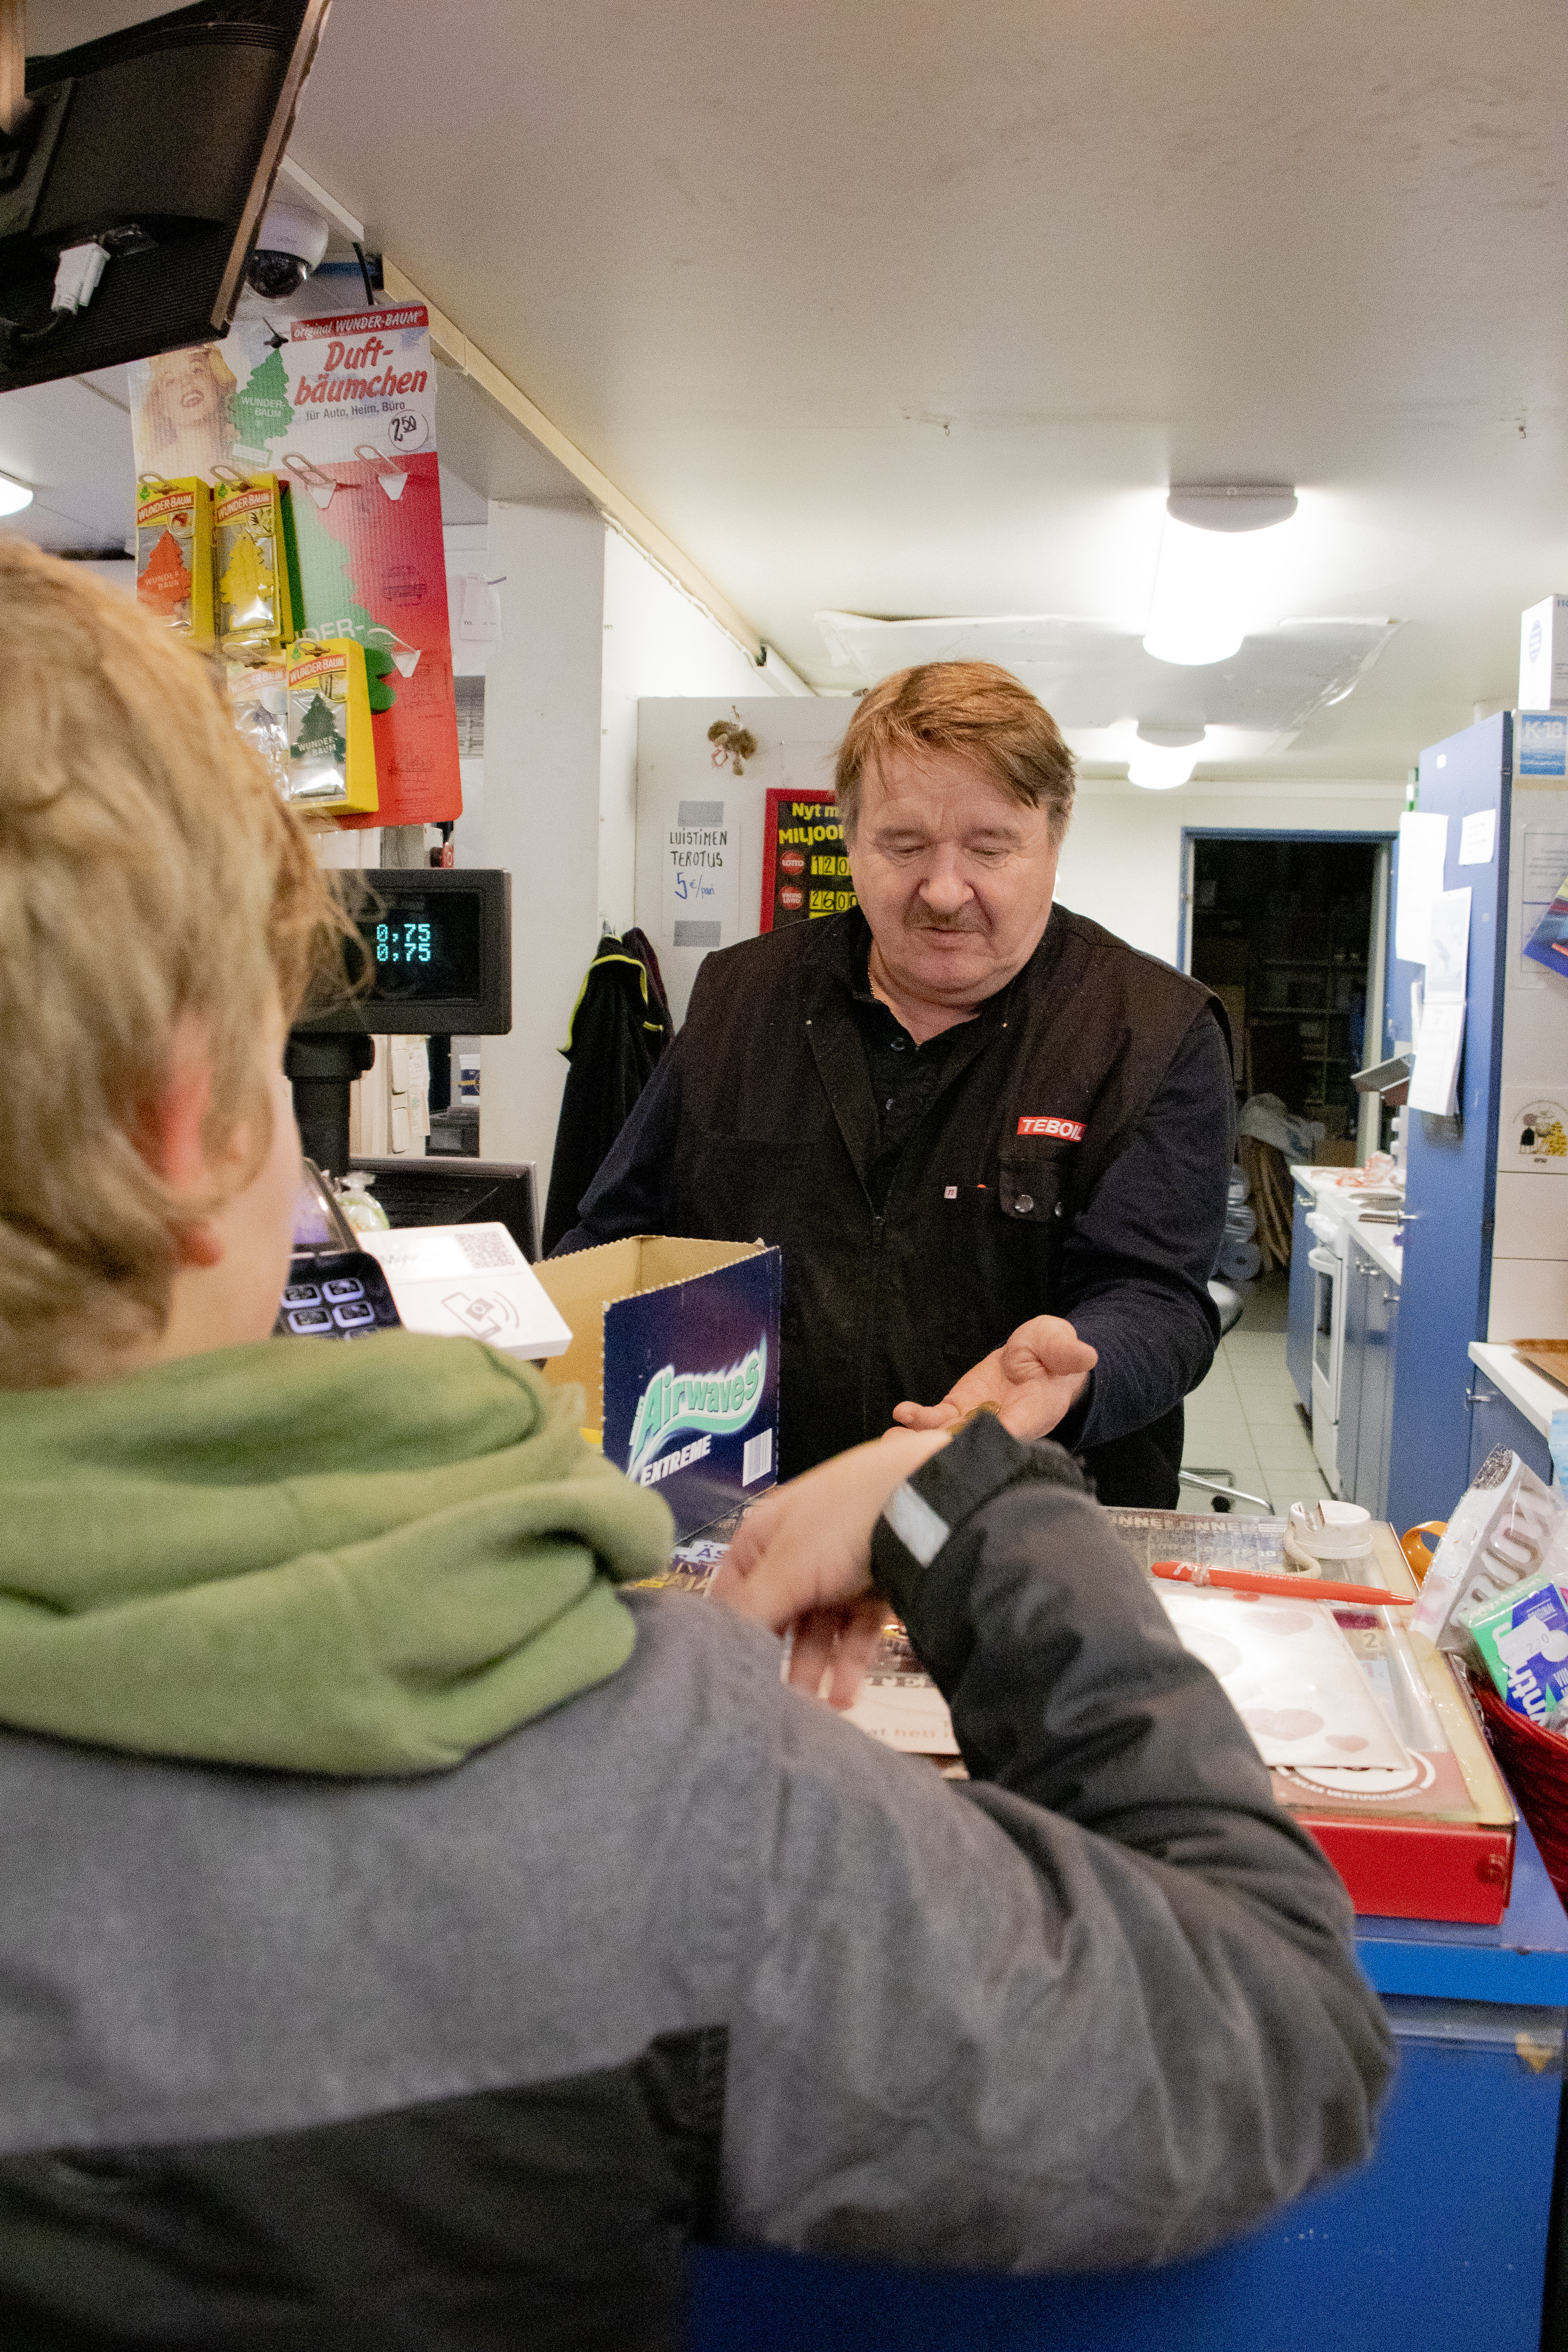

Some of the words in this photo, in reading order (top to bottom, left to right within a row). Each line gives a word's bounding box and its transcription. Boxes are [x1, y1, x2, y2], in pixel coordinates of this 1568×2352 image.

[294, 321, 332, 339] original
[324, 337, 393, 372] Duft-
[294, 366, 428, 406] bäumchen
[306, 410, 320, 421] für
[323, 407, 348, 419] Auto,
[351, 404, 380, 416] Heim,
[382, 401, 405, 412] Büro
[138, 495, 192, 521] WUNDER-BAUM
[218, 493, 269, 519] WUNDER-BAUM
[290, 657, 345, 683] WUNDER-BAUM
[1525, 720, 1563, 739] K-18
[792, 802, 820, 820] Nyt
[670, 850, 723, 868] TEROTUS
[376, 924, 431, 942] 0,75
[376, 943, 431, 962] 0,75
[1022, 1118, 1082, 1140] TEBOIL
[634, 1358, 759, 1463] Airwaves
[640, 1434, 712, 1488] EXTREME
